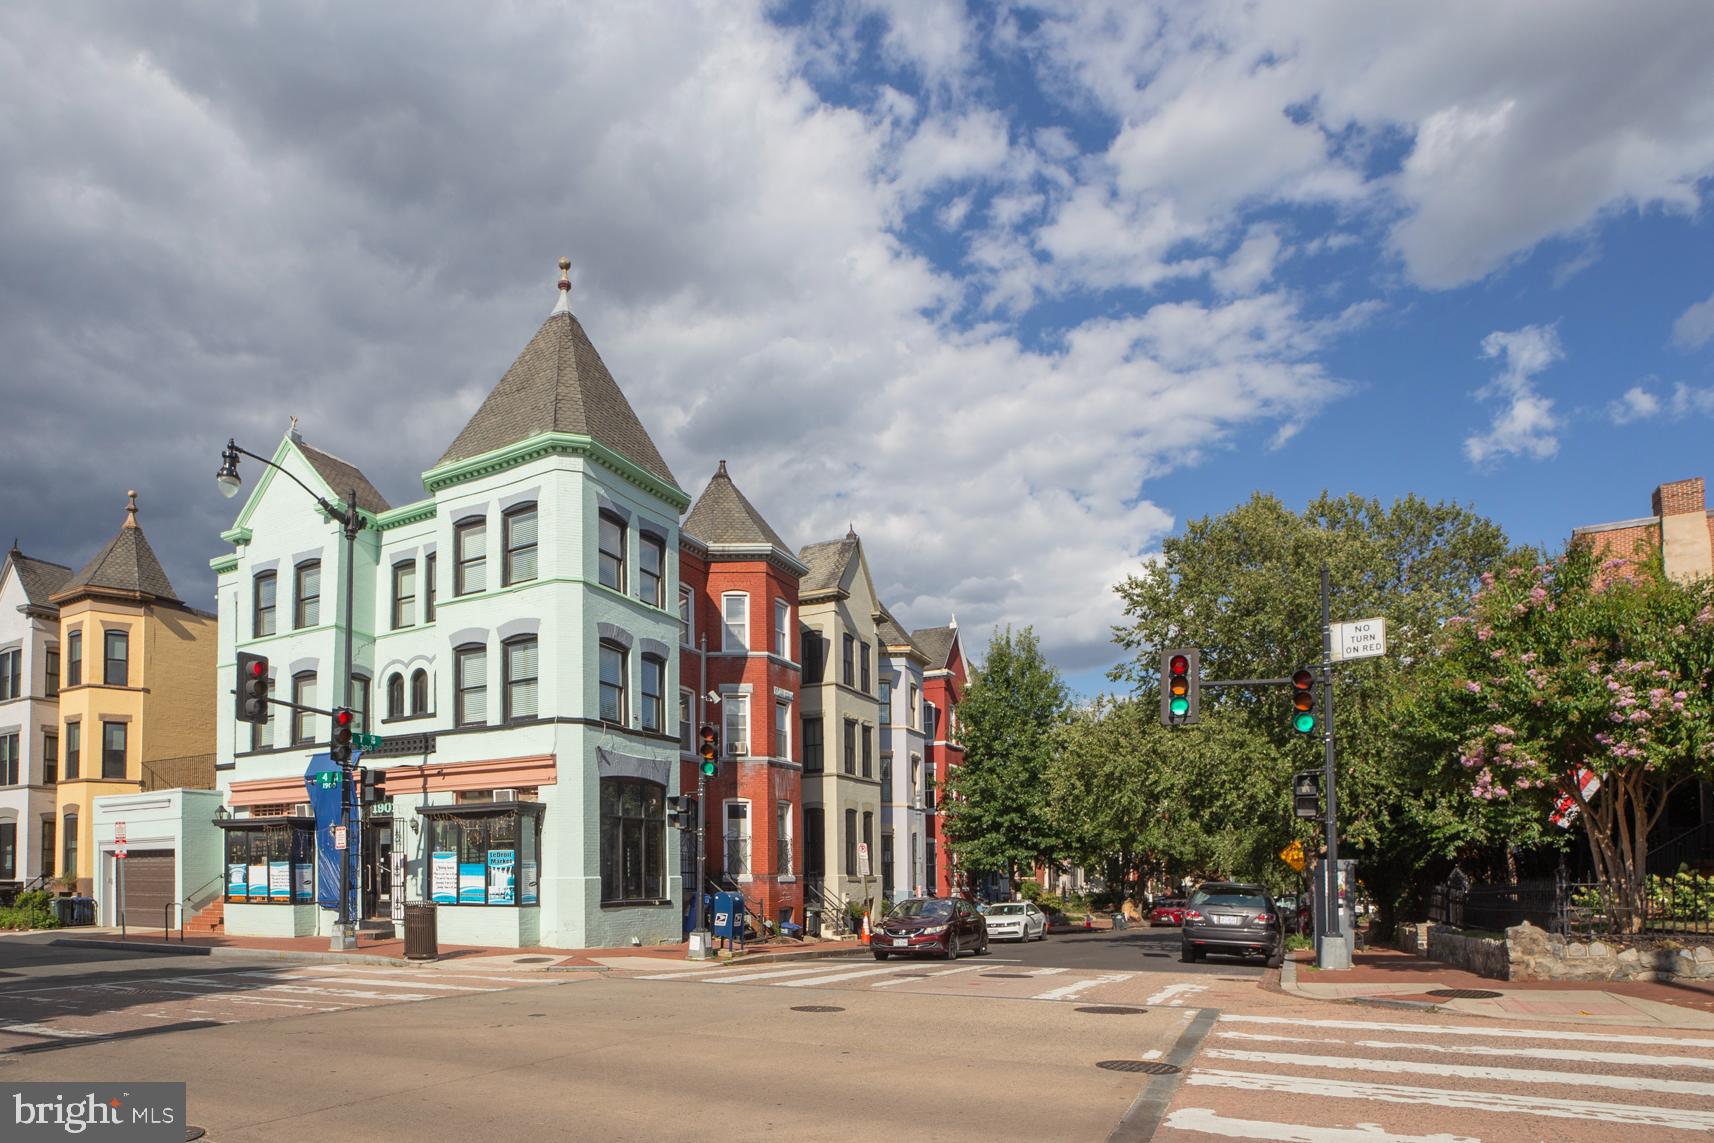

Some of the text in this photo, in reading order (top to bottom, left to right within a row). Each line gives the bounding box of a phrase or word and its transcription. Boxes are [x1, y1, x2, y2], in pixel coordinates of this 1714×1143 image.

[1355, 624, 1370, 633] NO
[1351, 634, 1376, 643] TURN
[1345, 643, 1382, 655] ON RED
[321, 772, 328, 781] 4
